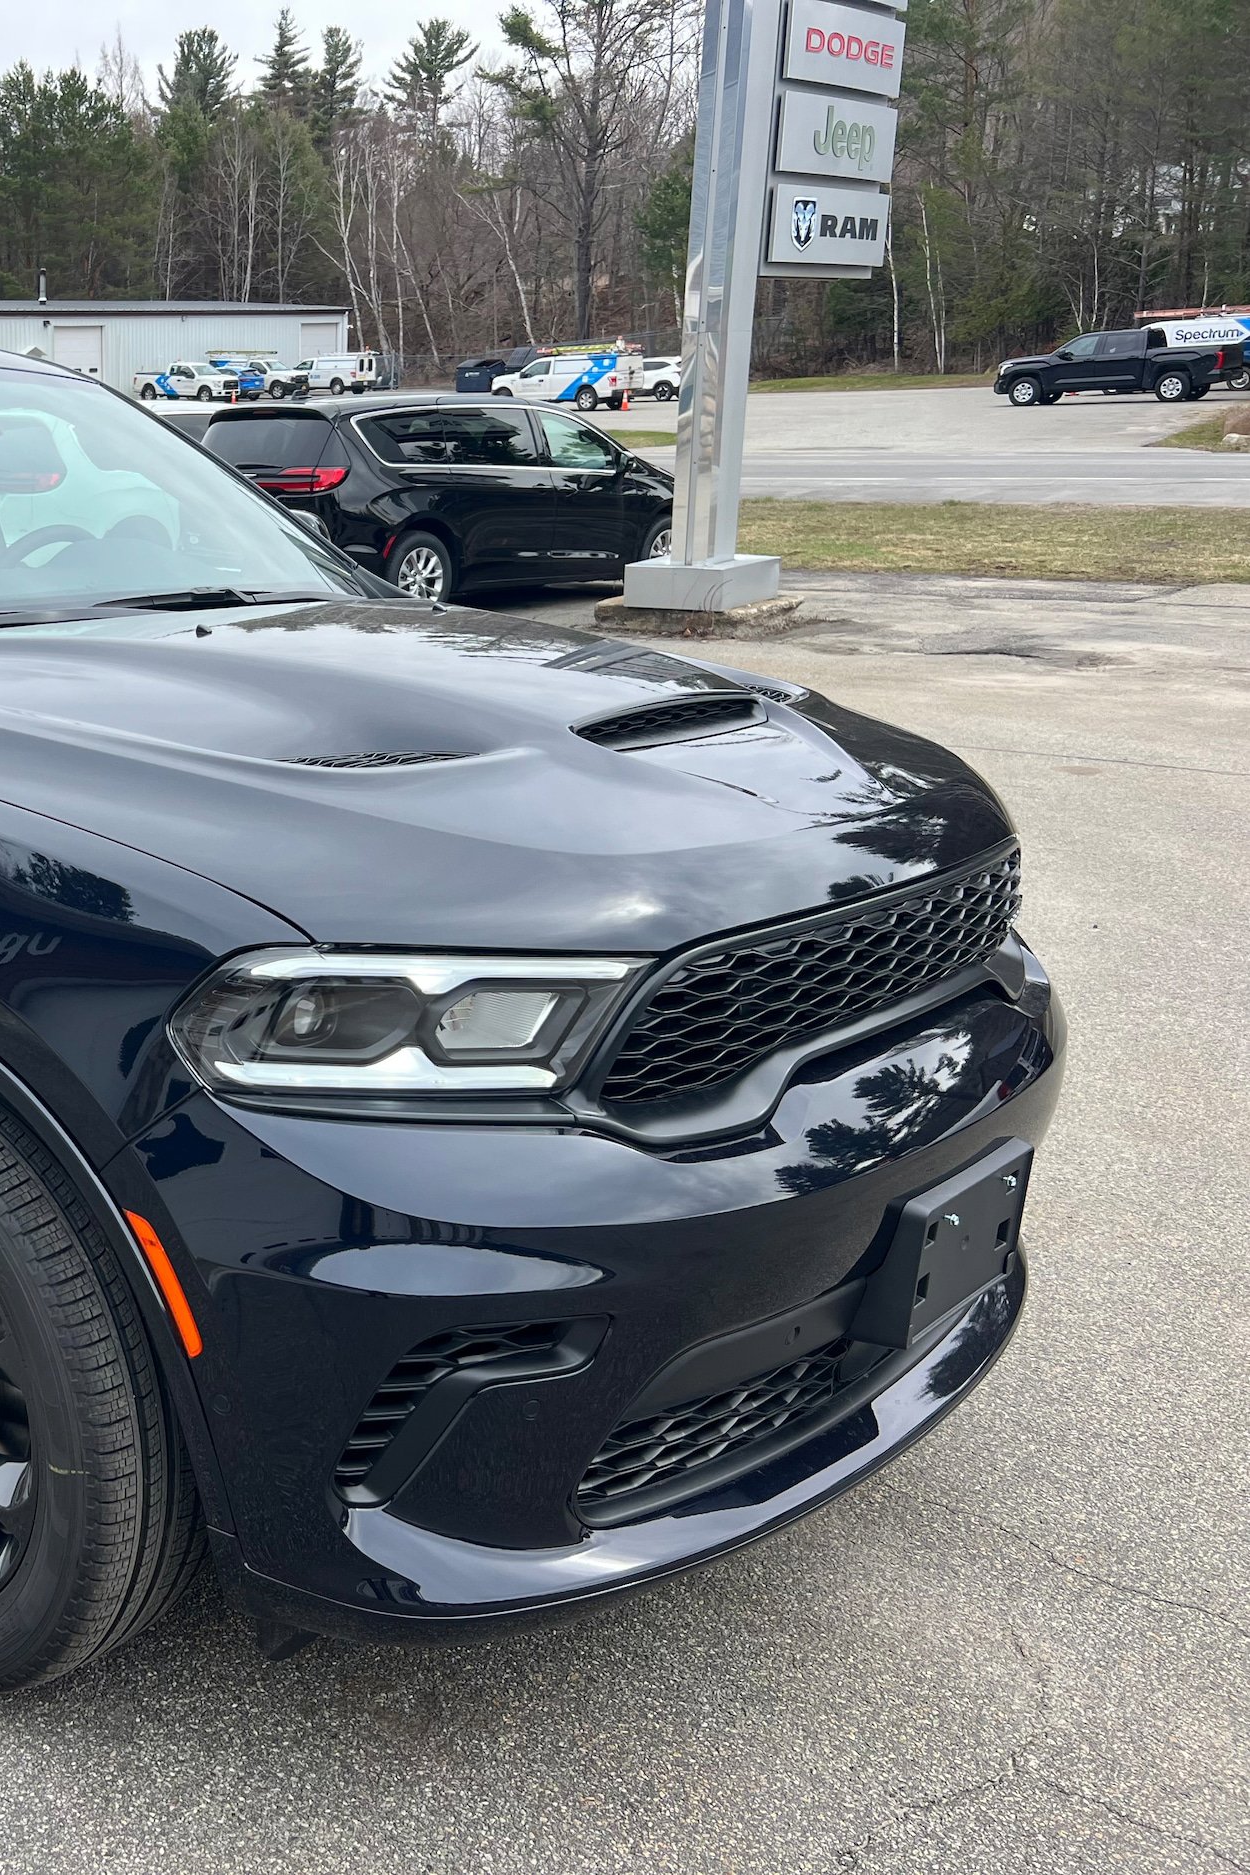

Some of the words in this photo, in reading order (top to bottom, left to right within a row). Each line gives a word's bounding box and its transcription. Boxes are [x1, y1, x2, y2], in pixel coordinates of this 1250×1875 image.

[805, 27, 895, 69] DODGE
[813, 105, 876, 171] Jeep
[819, 214, 879, 241] RAM
[1175, 328, 1240, 343] Spectrum
